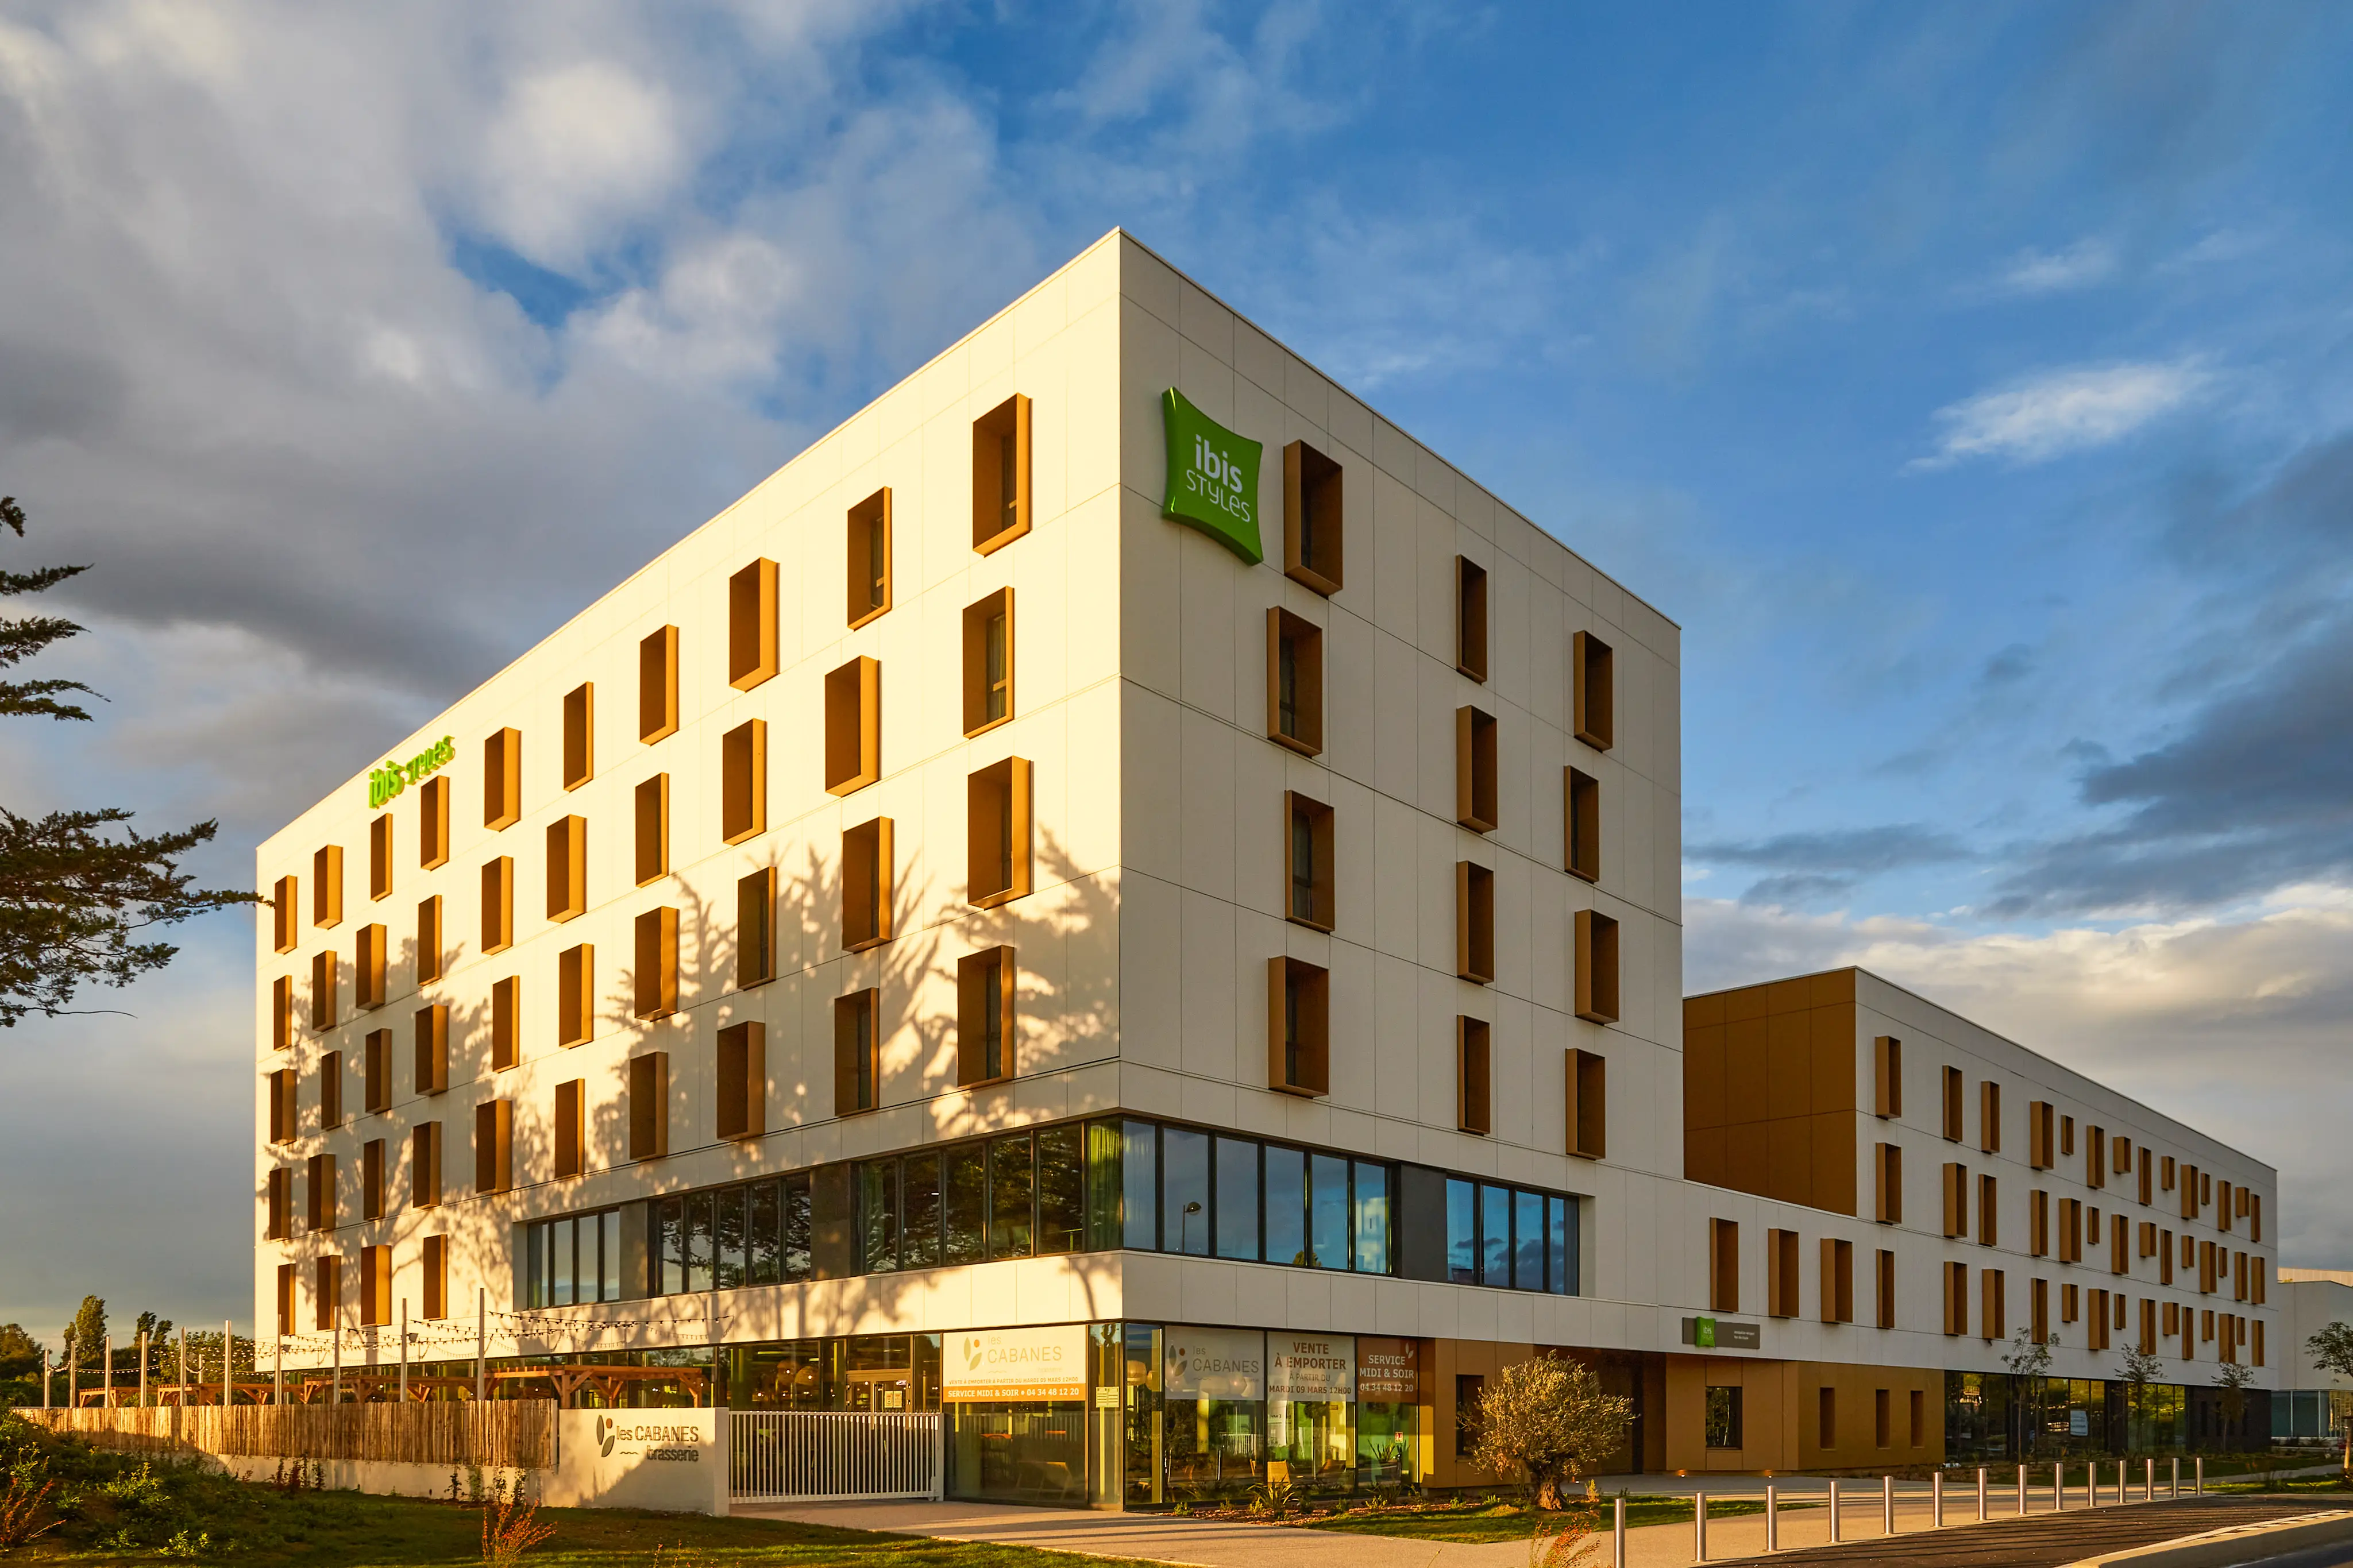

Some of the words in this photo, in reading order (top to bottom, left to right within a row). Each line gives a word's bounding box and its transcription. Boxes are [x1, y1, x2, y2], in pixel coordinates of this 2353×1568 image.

[1195, 434, 1243, 493] ibis
[369, 760, 405, 809] ibis
[988, 1335, 1001, 1345] les
[1293, 1342, 1329, 1354] VENTE
[988, 1346, 1062, 1364] CABANES
[1274, 1352, 1282, 1367] À
[1287, 1357, 1347, 1370] EMPORTER
[1368, 1354, 1406, 1365] SERVICE
[1193, 1358, 1259, 1373] CABANES
[1296, 1373, 1319, 1381] PARTIR
[1321, 1374, 1330, 1382] DU
[1360, 1368, 1381, 1377] MIDI
[1384, 1368, 1390, 1378] &
[1393, 1369, 1414, 1378] SOIR
[948, 1389, 975, 1397] SERVICE
[1059, 1388, 1068, 1396] 12
[1269, 1385, 1294, 1393] MARDI
[1296, 1385, 1305, 1393] 09
[1307, 1386, 1327, 1394] MARS
[1330, 1387, 1351, 1395] 12H00
[1360, 1383, 1369, 1391] 04
[1372, 1383, 1380, 1391] 34
[1382, 1383, 1391, 1392] 48
[1394, 1384, 1402, 1392] 12
[1405, 1384, 1413, 1392] 20
[616, 1426, 632, 1440] les
[635, 1426, 699, 1442] CABANES
[647, 1445, 699, 1462] brasserie
